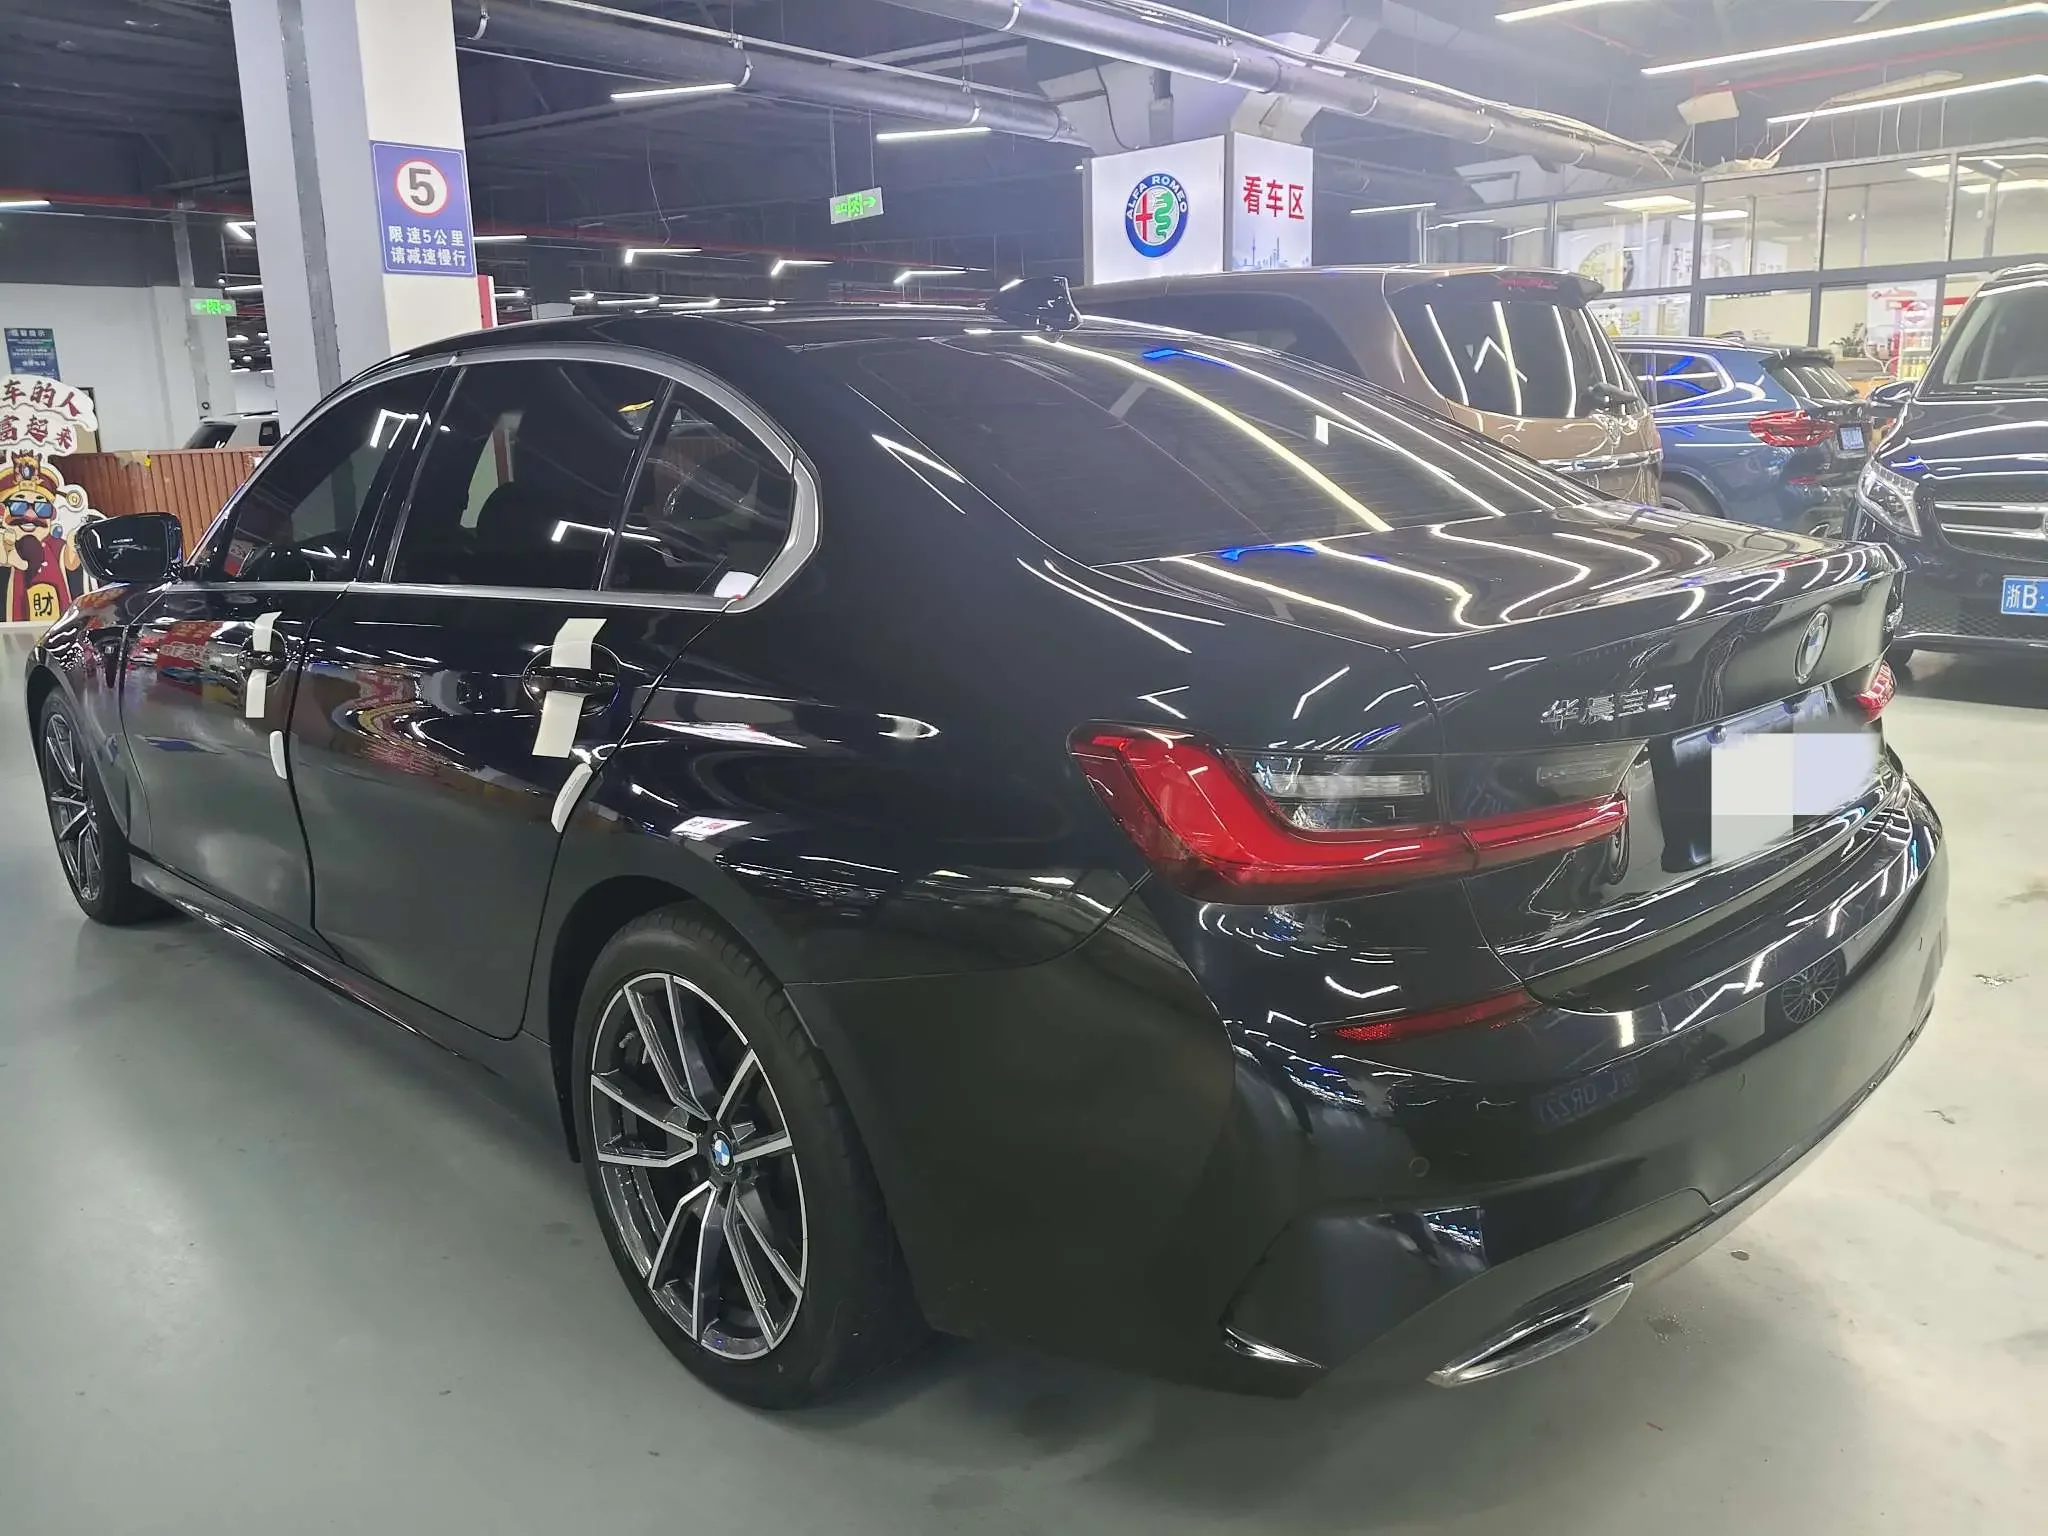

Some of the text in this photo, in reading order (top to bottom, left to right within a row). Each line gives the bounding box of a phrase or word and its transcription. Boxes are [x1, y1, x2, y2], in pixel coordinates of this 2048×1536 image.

[409, 168, 434, 206] 5
[1126, 175, 1186, 219] ALFA ROMEO
[1244, 175, 1304, 219] 看车区
[388, 226, 464, 246] 限速5公里
[390, 247, 467, 266] 请减速慢行
[3, 379, 82, 416] 车的人
[33, 592, 53, 616] 財
